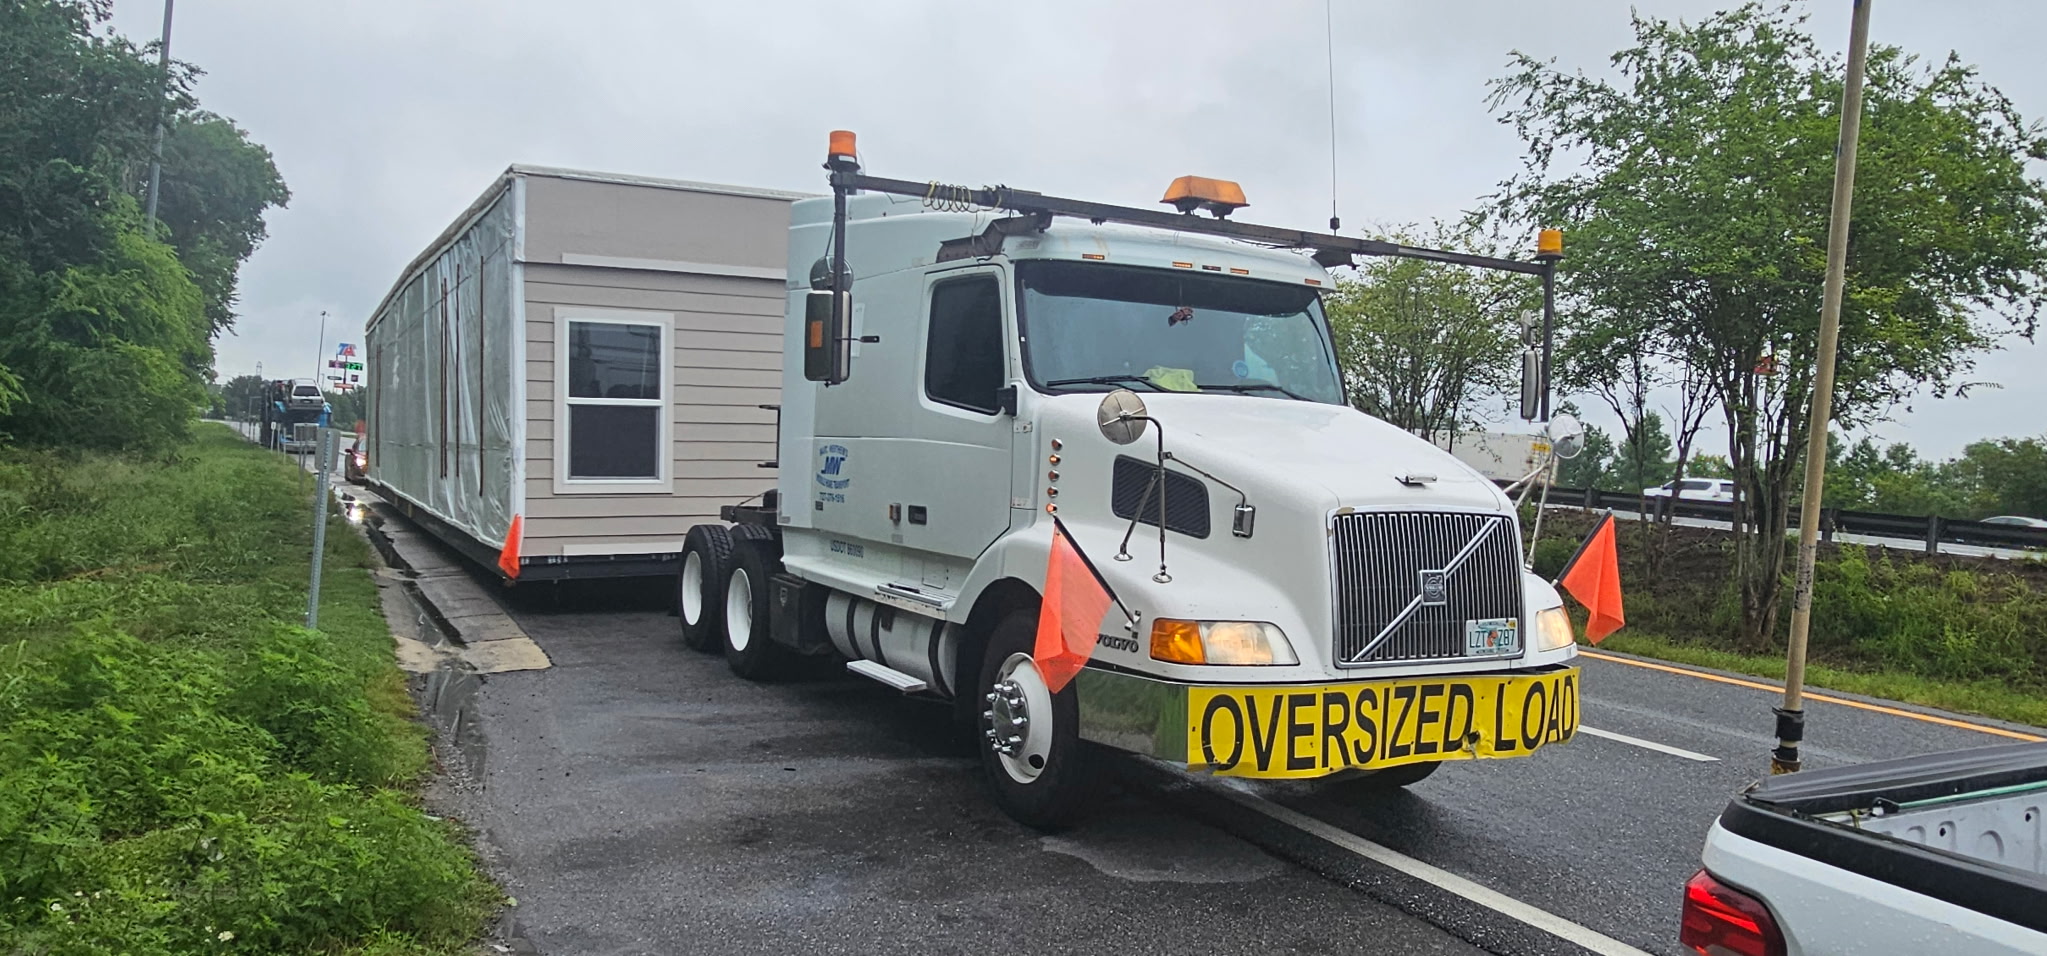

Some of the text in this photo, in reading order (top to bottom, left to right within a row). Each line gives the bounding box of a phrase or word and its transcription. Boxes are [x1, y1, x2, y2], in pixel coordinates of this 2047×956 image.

[1469, 630, 1488, 648] LZT
[1201, 675, 1575, 772] OVERSIZED LOAD
